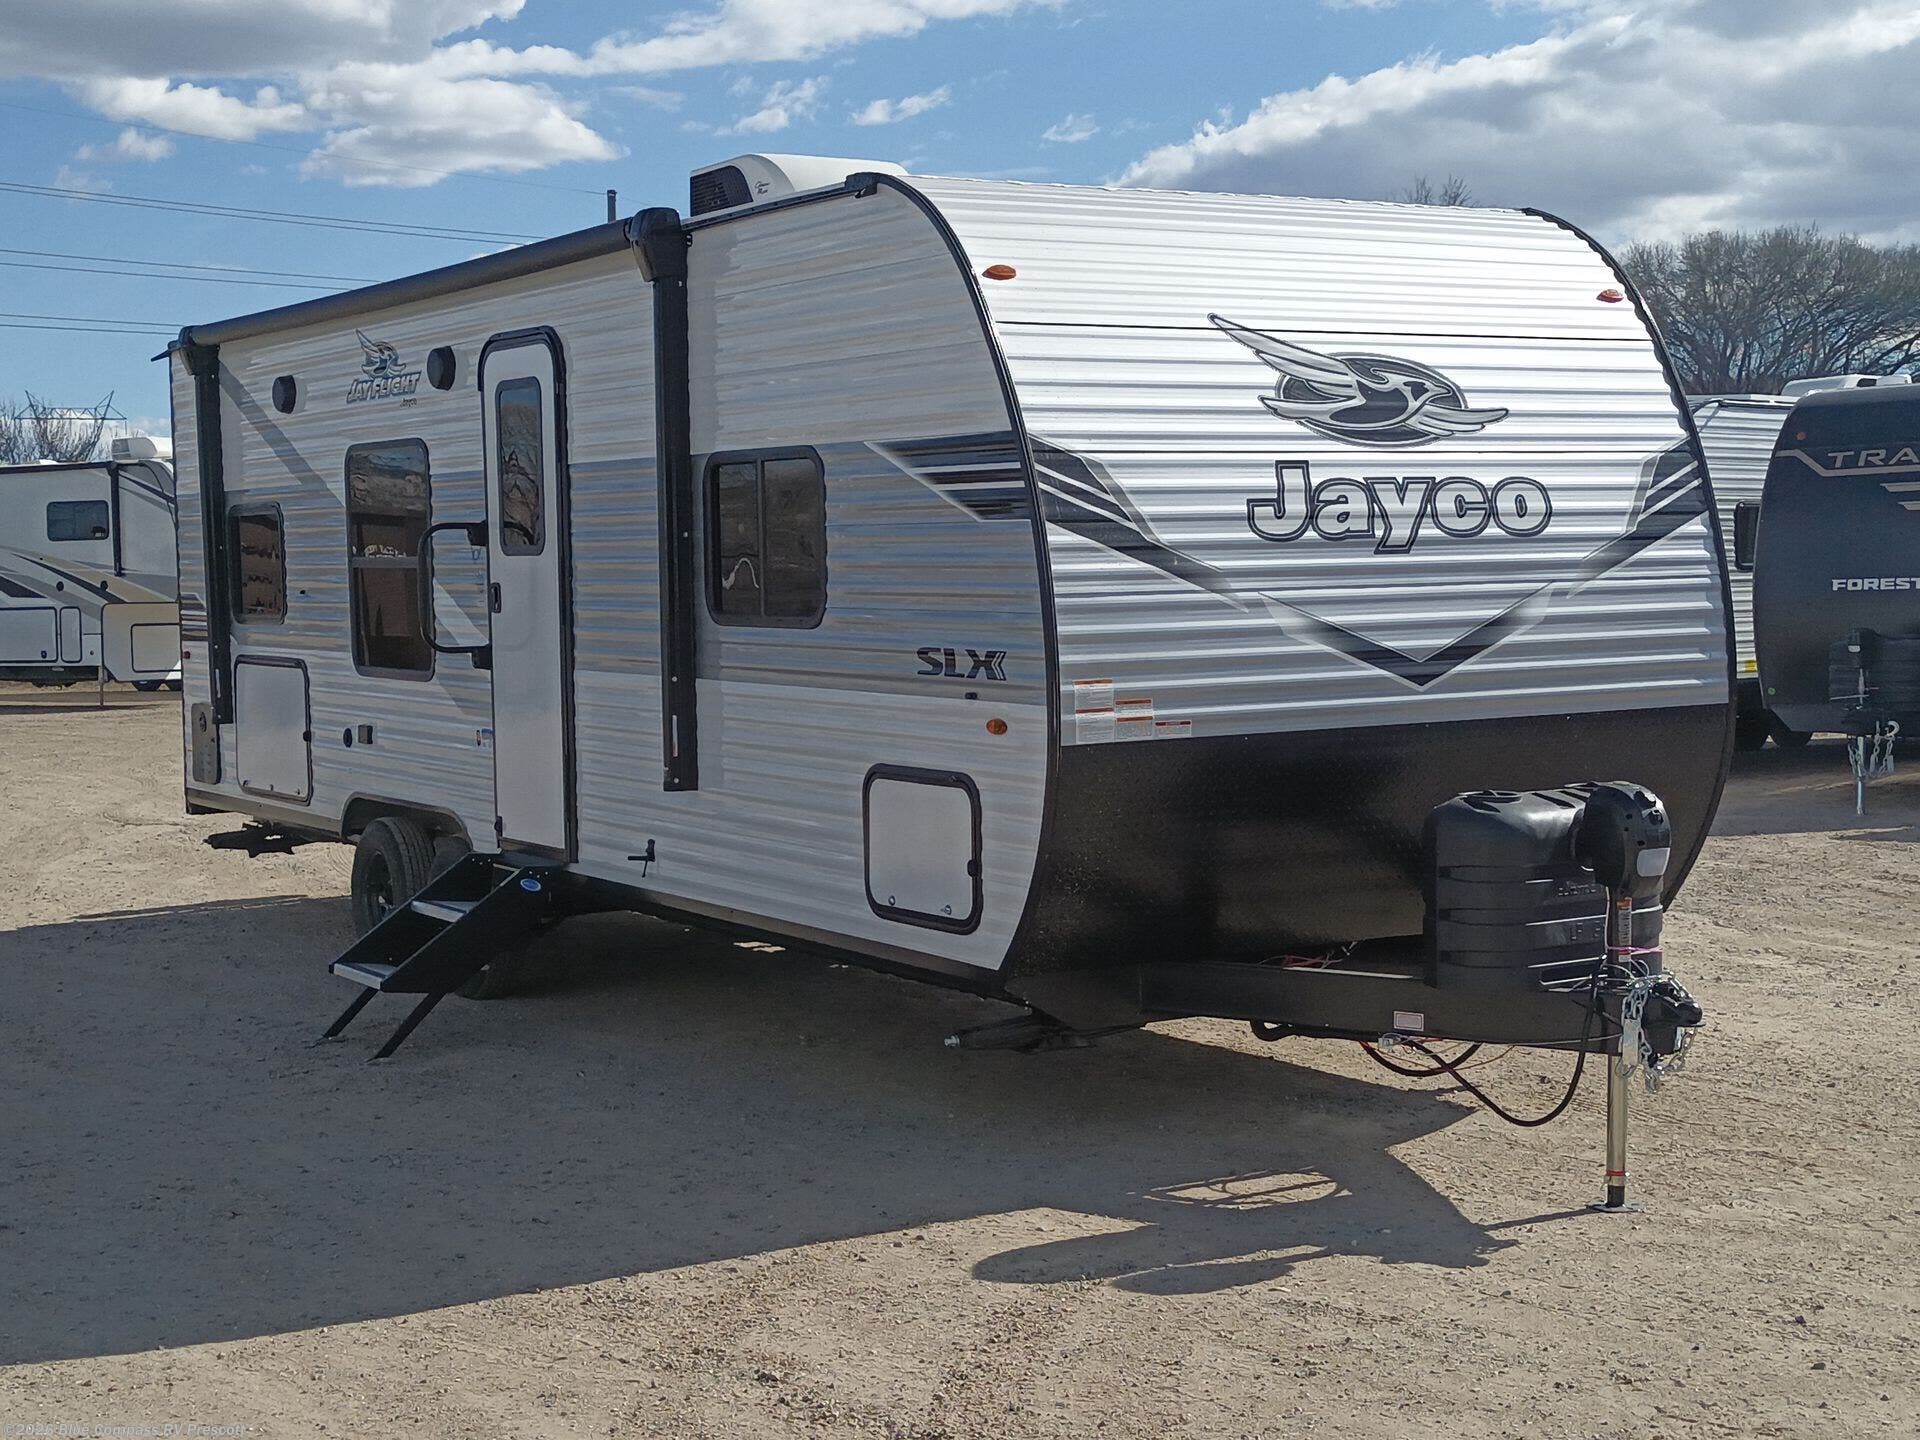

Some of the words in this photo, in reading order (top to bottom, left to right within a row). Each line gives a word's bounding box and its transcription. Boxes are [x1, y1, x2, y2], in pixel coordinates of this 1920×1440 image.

[1827, 447, 1920, 468] TRA
[1246, 460, 1553, 554] Jayco
[1831, 577, 1920, 591] FOREST
[916, 646, 1007, 681] SLX
